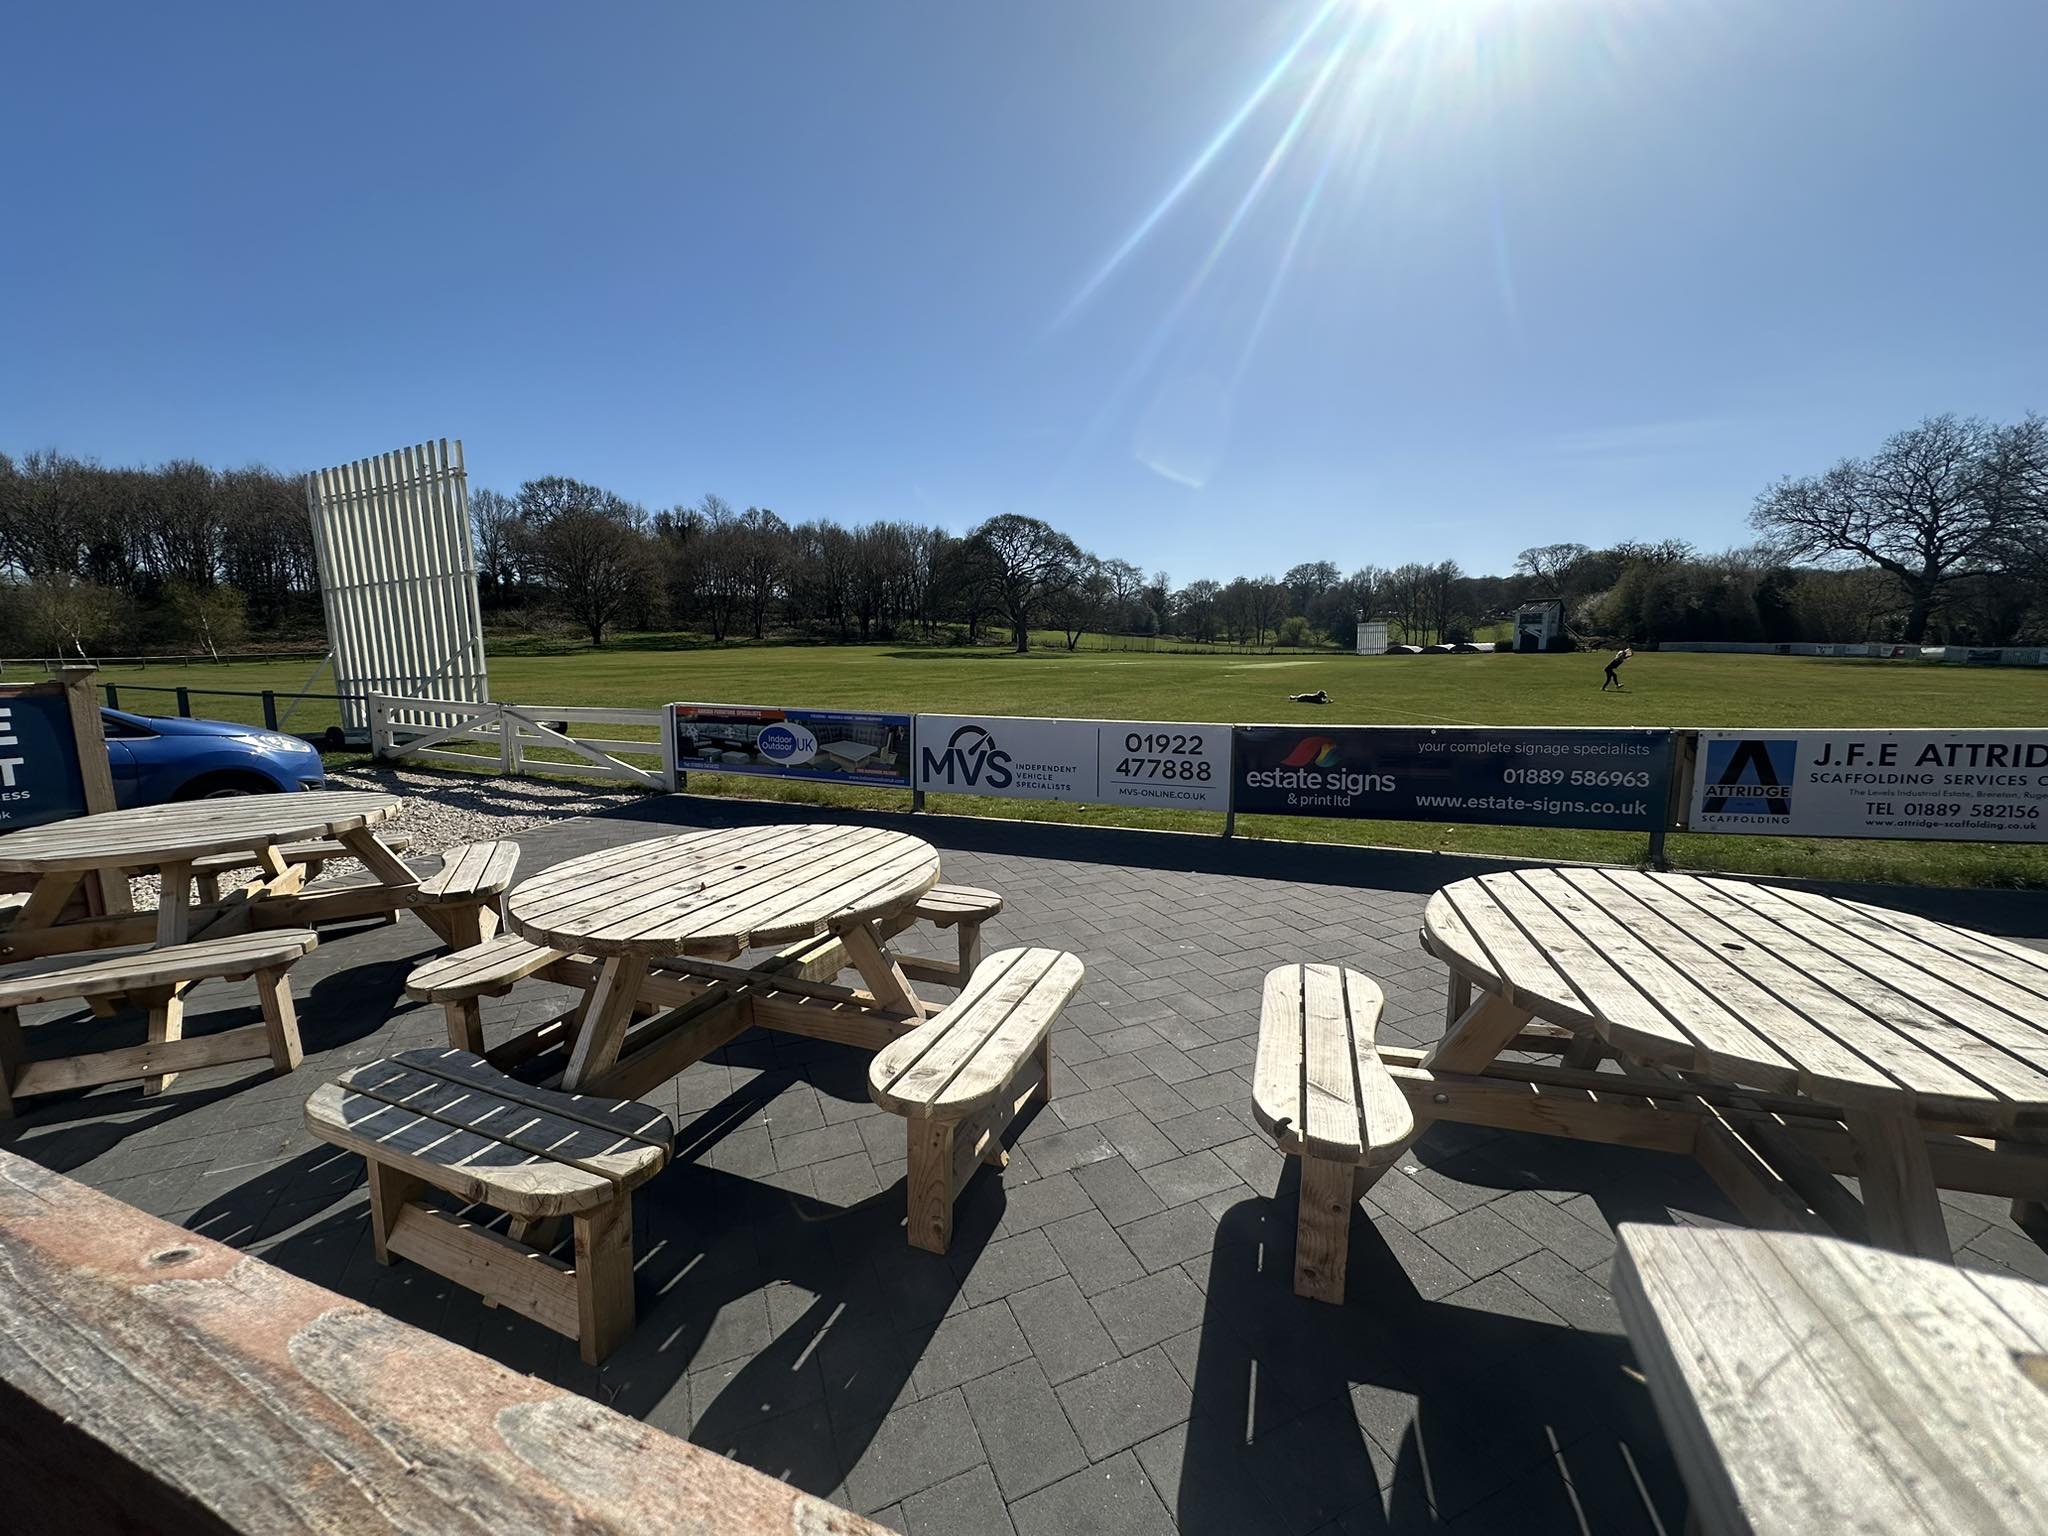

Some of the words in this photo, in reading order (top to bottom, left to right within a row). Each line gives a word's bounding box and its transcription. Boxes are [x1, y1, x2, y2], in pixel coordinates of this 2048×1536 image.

[767, 734, 793, 744] Indoor
[797, 738, 814, 753] UK
[1125, 732, 1203, 756] 01922
[762, 741, 793, 752] Outdoor
[1417, 742, 1446, 754] your
[1450, 740, 1511, 756] complete
[1514, 742, 1570, 757] signage
[1573, 741, 1650, 758] specialists
[1813, 743, 1899, 767] J.F.E
[1914, 743, 2048, 768] ATTRID
[922, 745, 1013, 790] MVS
[1015, 763, 1077, 774] INDEPENDENT
[1116, 757, 1212, 782] 477888
[1016, 772, 1053, 781] VEHICLE
[1246, 767, 1322, 789] estate
[1326, 767, 1396, 796] signs
[1503, 768, 1565, 785] 01889
[1569, 769, 1650, 788] 586963
[1810, 772, 1934, 785] SCAFFOLDING
[1944, 773, 2028, 786] SERVICES
[1015, 781, 1072, 791] SPECIALISTS
[1705, 785, 1790, 798] ATTRIDGE
[1849, 788, 1866, 797] The
[1897, 788, 1941, 798] Industrial
[0, 790, 31, 802] ESS
[1119, 787, 1206, 801] MVS-ONLINE.CO.UK
[1287, 792, 1298, 805] &
[1299, 792, 1333, 808] print
[1333, 793, 1351, 807] ltd
[1415, 793, 1647, 817] www.estate-signs.co.uk
[1866, 802, 1894, 816] TEL
[1903, 802, 1961, 817] 01889
[1970, 803, 2040, 819] 582156
[1701, 814, 1790, 825] SCAFFOLDING
[1865, 818, 2037, 831] www.attridge-scaffolding.co.uk
